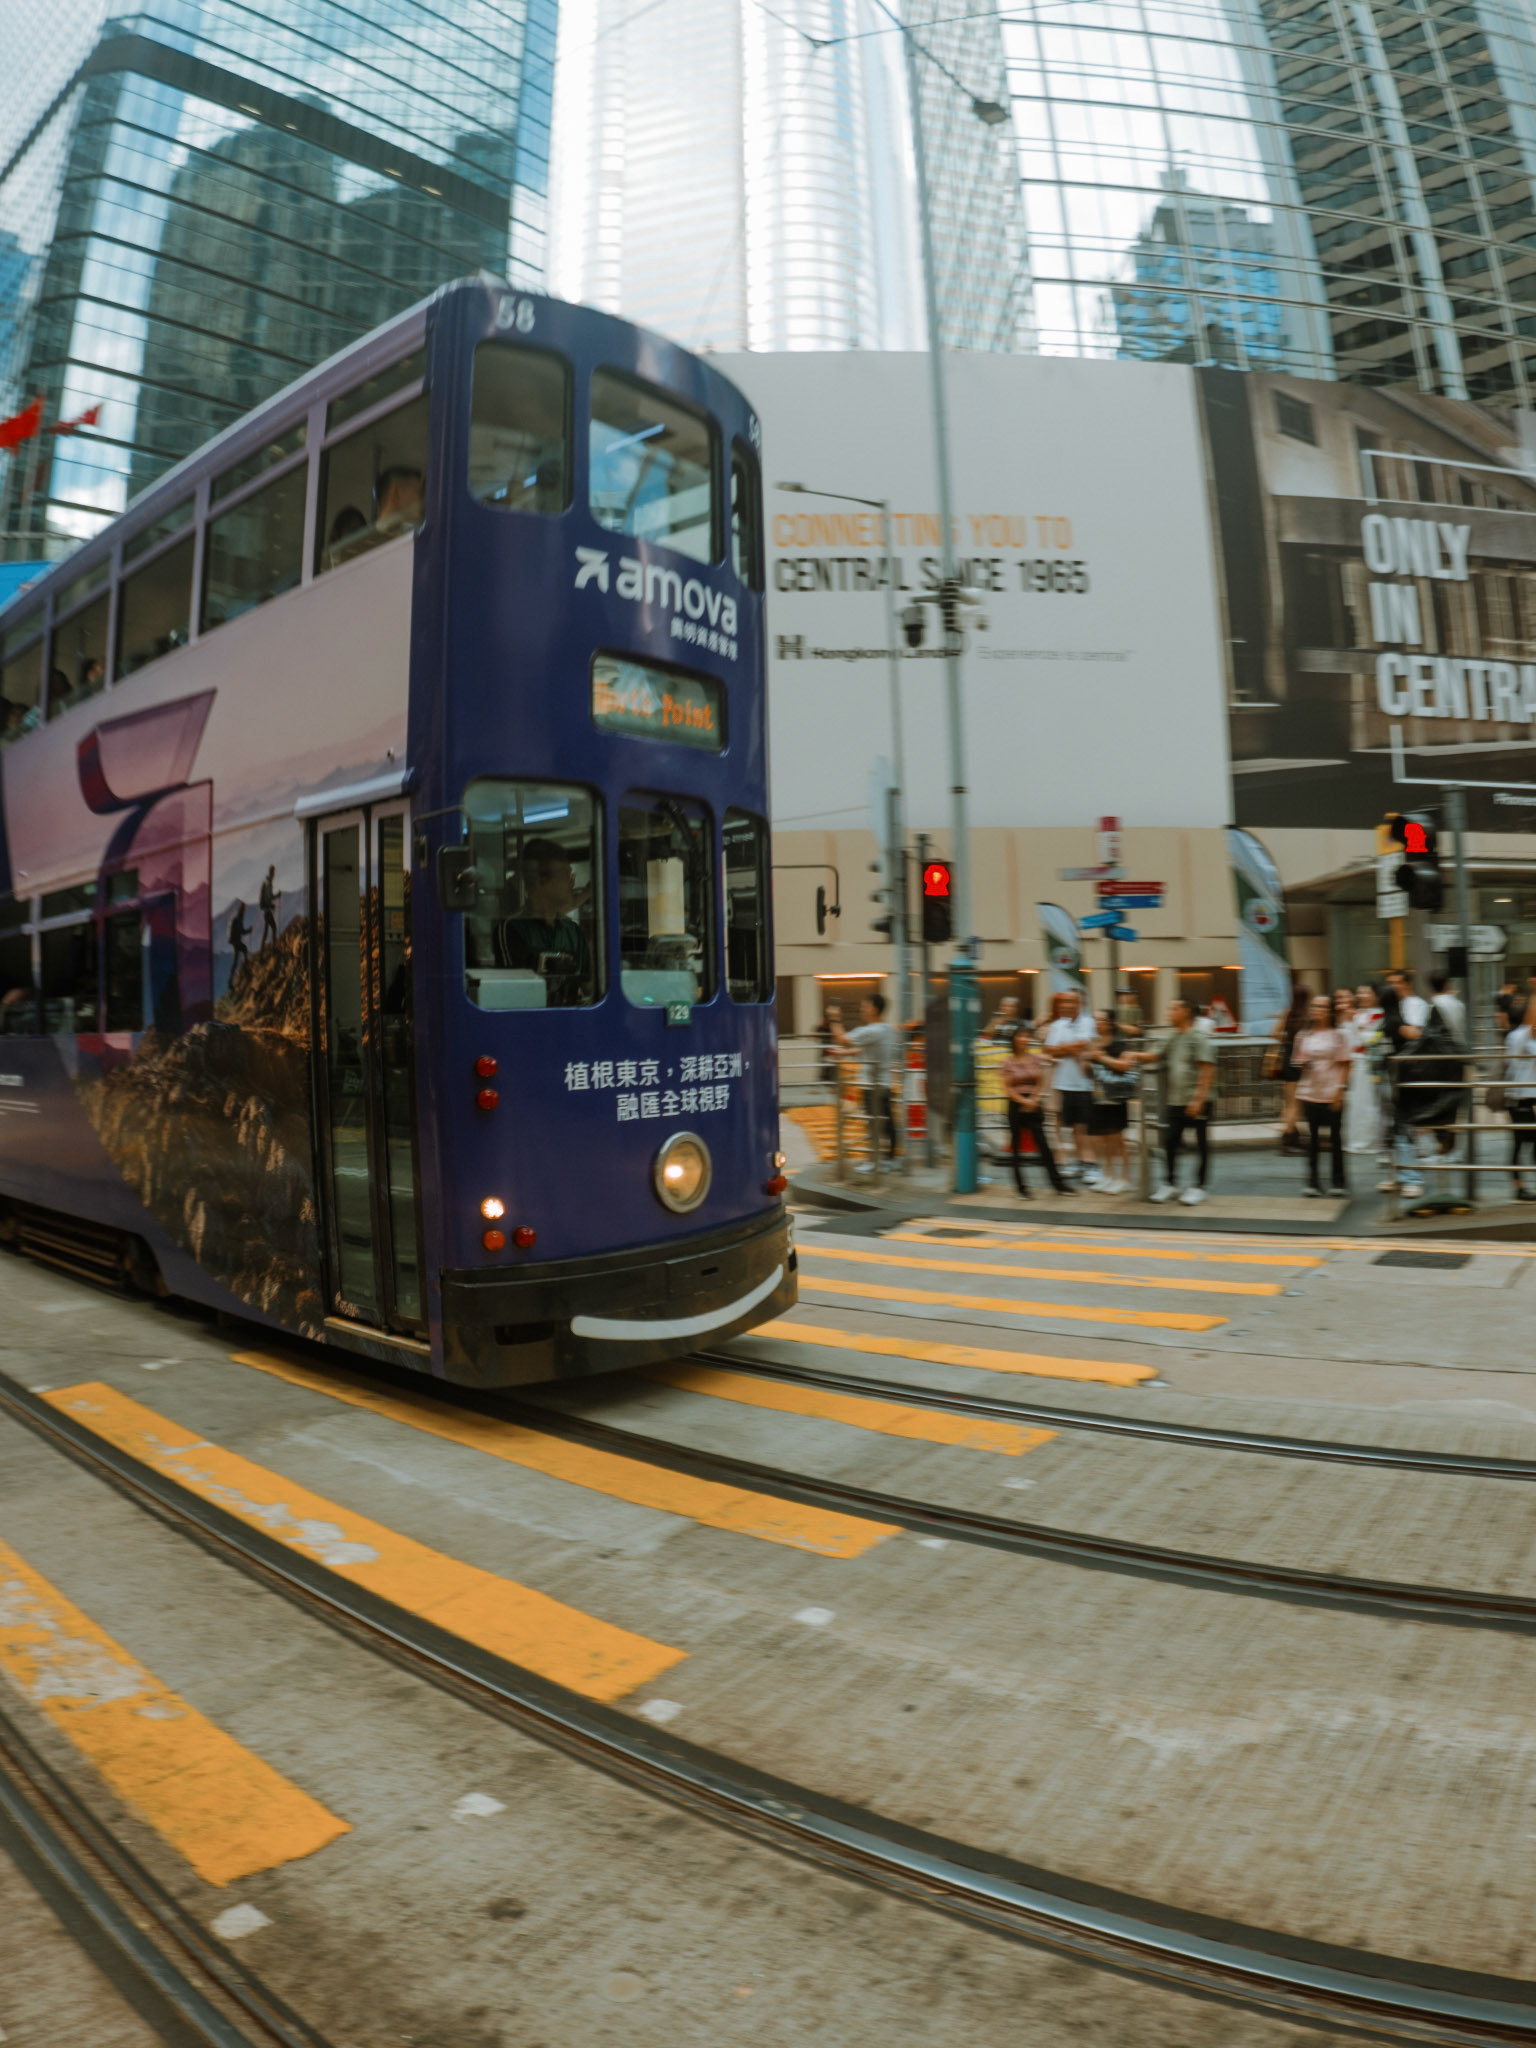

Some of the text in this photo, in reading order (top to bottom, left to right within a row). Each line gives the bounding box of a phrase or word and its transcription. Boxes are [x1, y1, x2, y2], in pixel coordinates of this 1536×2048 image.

[966, 513, 1027, 548] YOU
[1032, 515, 1074, 550] TO
[1361, 513, 1471, 581] ONLY
[774, 557, 1091, 595] CENTRAL SNCE 1965
[615, 555, 738, 637] amova
[1368, 582, 1423, 645] IN
[660, 692, 715, 731] Point
[616, 1084, 730, 1122] 融匯全球視野
